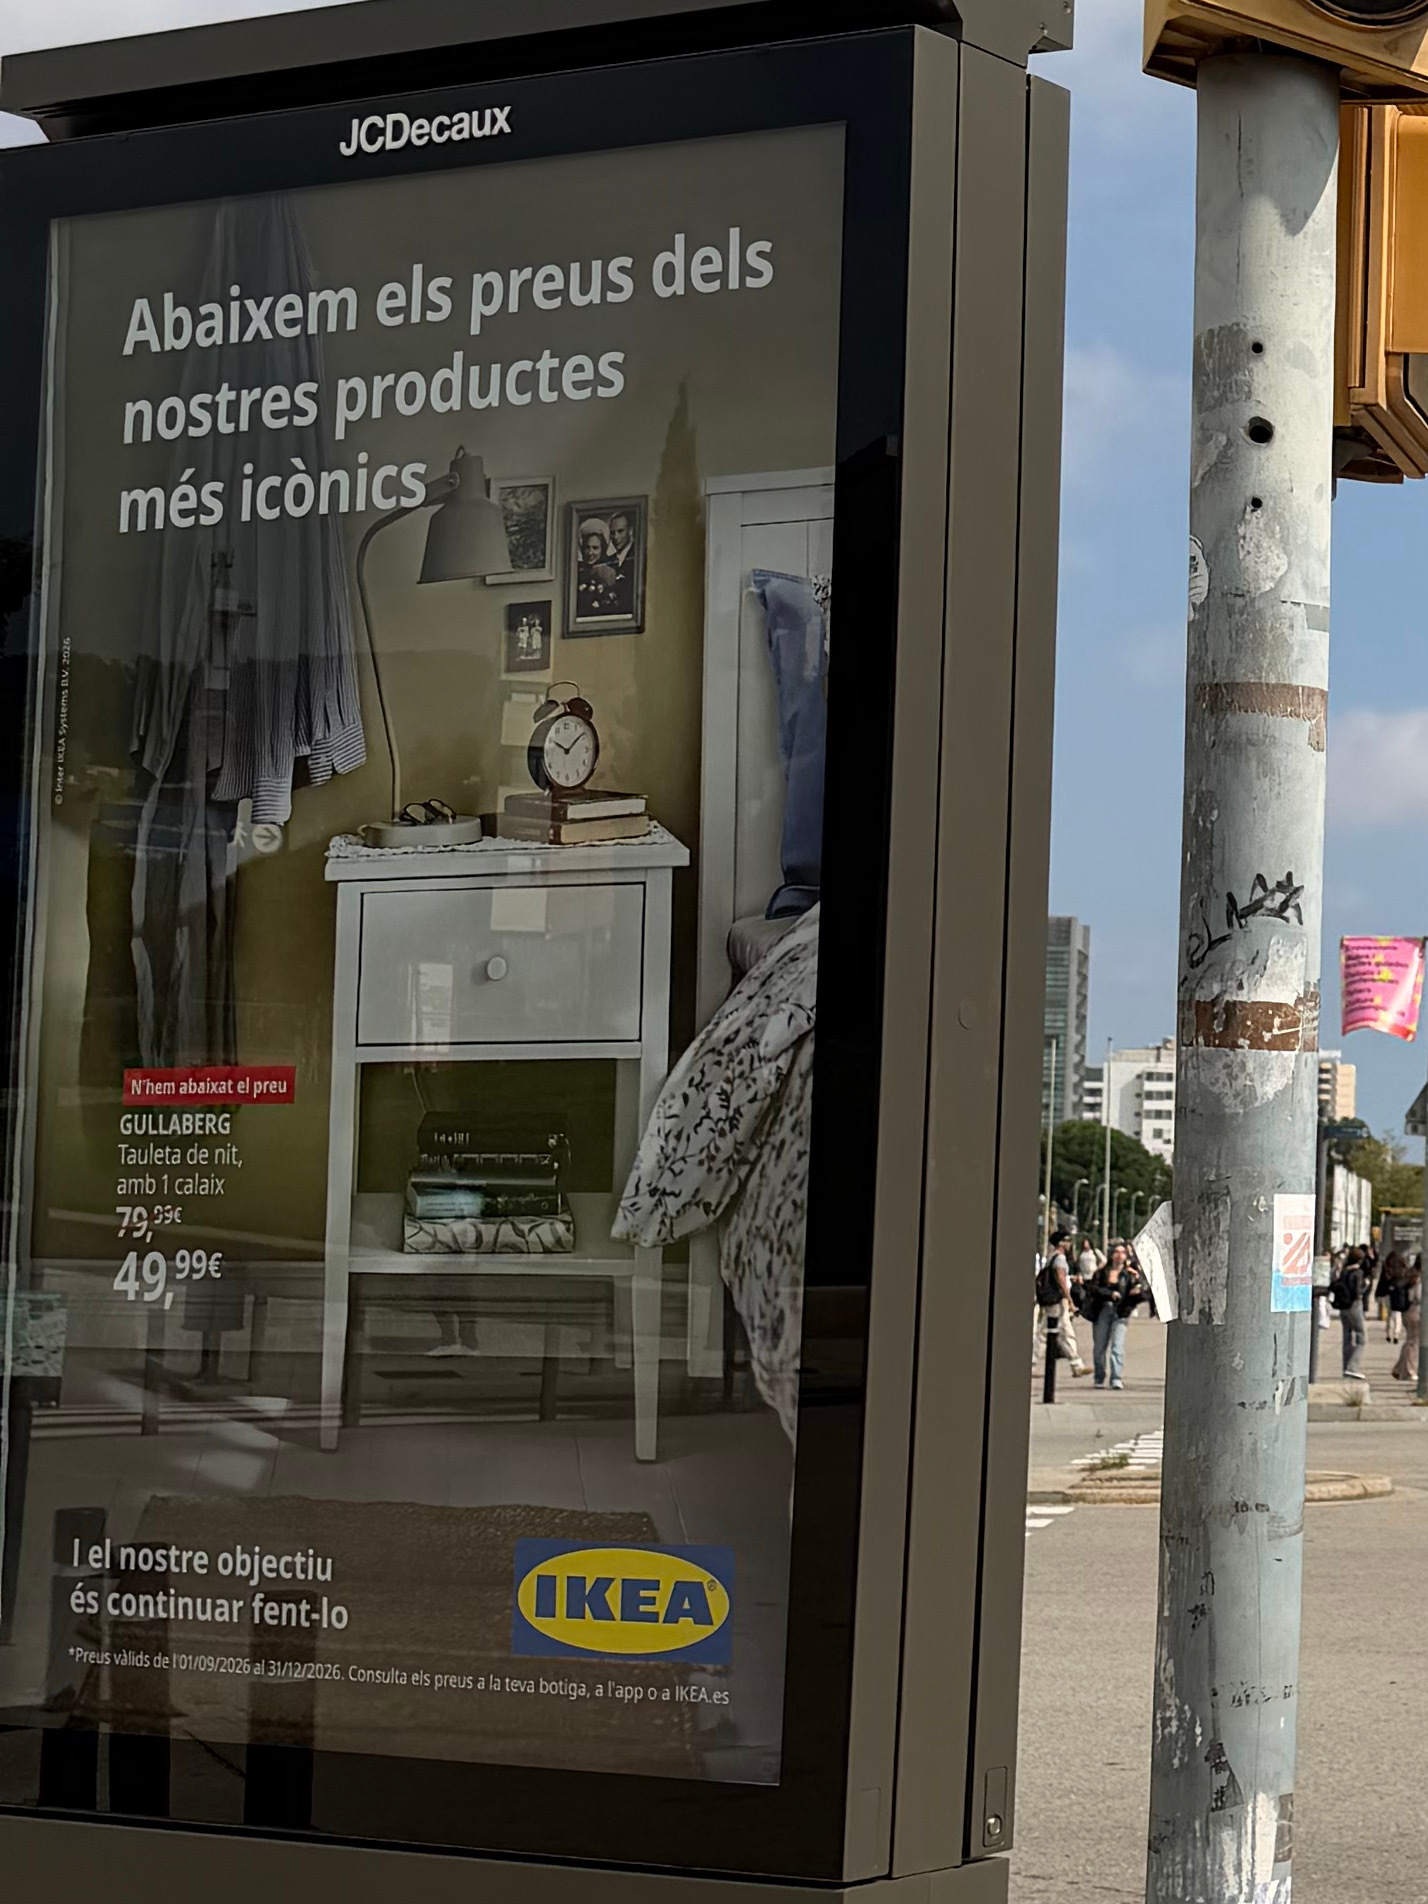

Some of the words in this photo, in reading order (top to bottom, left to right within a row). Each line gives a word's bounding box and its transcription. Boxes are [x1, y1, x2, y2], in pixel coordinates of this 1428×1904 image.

[339, 104, 513, 157] JCDecaux
[122, 283, 360, 357] Abaixem
[375, 262, 452, 328] els
[469, 253, 635, 336] preus
[650, 226, 776, 298] dels
[122, 375, 319, 445] nostres
[334, 347, 626, 441] productes
[118, 465, 225, 534] més
[239, 449, 429, 524] icònics
[131, 1077, 175, 1095] N'hem
[179, 1077, 233, 1096] abaixat
[237, 1077, 250, 1095] el
[253, 1078, 287, 1098] preu
[119, 1113, 231, 1136] GULLABERG
[118, 1143, 182, 1166] Tauleta
[186, 1143, 209, 1165] de
[214, 1143, 243, 1168] nit,
[117, 1174, 156, 1195] amb
[162, 1174, 168, 1195] 1
[174, 1173, 225, 1195] calaix
[113, 1249, 223, 1310] 49,99€
[88, 1538, 112, 1570] el
[119, 1544, 209, 1579] nostre
[217, 1545, 333, 1586] objectiu
[70, 1582, 99, 1616] és
[106, 1585, 245, 1625] continuar
[251, 1591, 349, 1630] fent-lo
[534, 1573, 716, 1627] IKEA
[113, 1648, 150, 1668] vàlids
[153, 1654, 169, 1669] de
[253, 1660, 265, 1675] al
[267, 1660, 345, 1681] 31/12/2026.
[348, 1664, 408, 1686] Consulta
[411, 1670, 431, 1687] els
[434, 1673, 473, 1691] preus
[477, 1677, 485, 1690] a
[489, 1673, 501, 1691] la
[505, 1677, 535, 1694] teva
[539, 1677, 591, 1700] botiga,
[595, 1684, 604, 1697] a
[607, 1682, 643, 1704] l'app
[648, 1686, 658, 1701] o
[661, 1688, 670, 1701] a
[674, 1684, 730, 1705] IKEA.es
